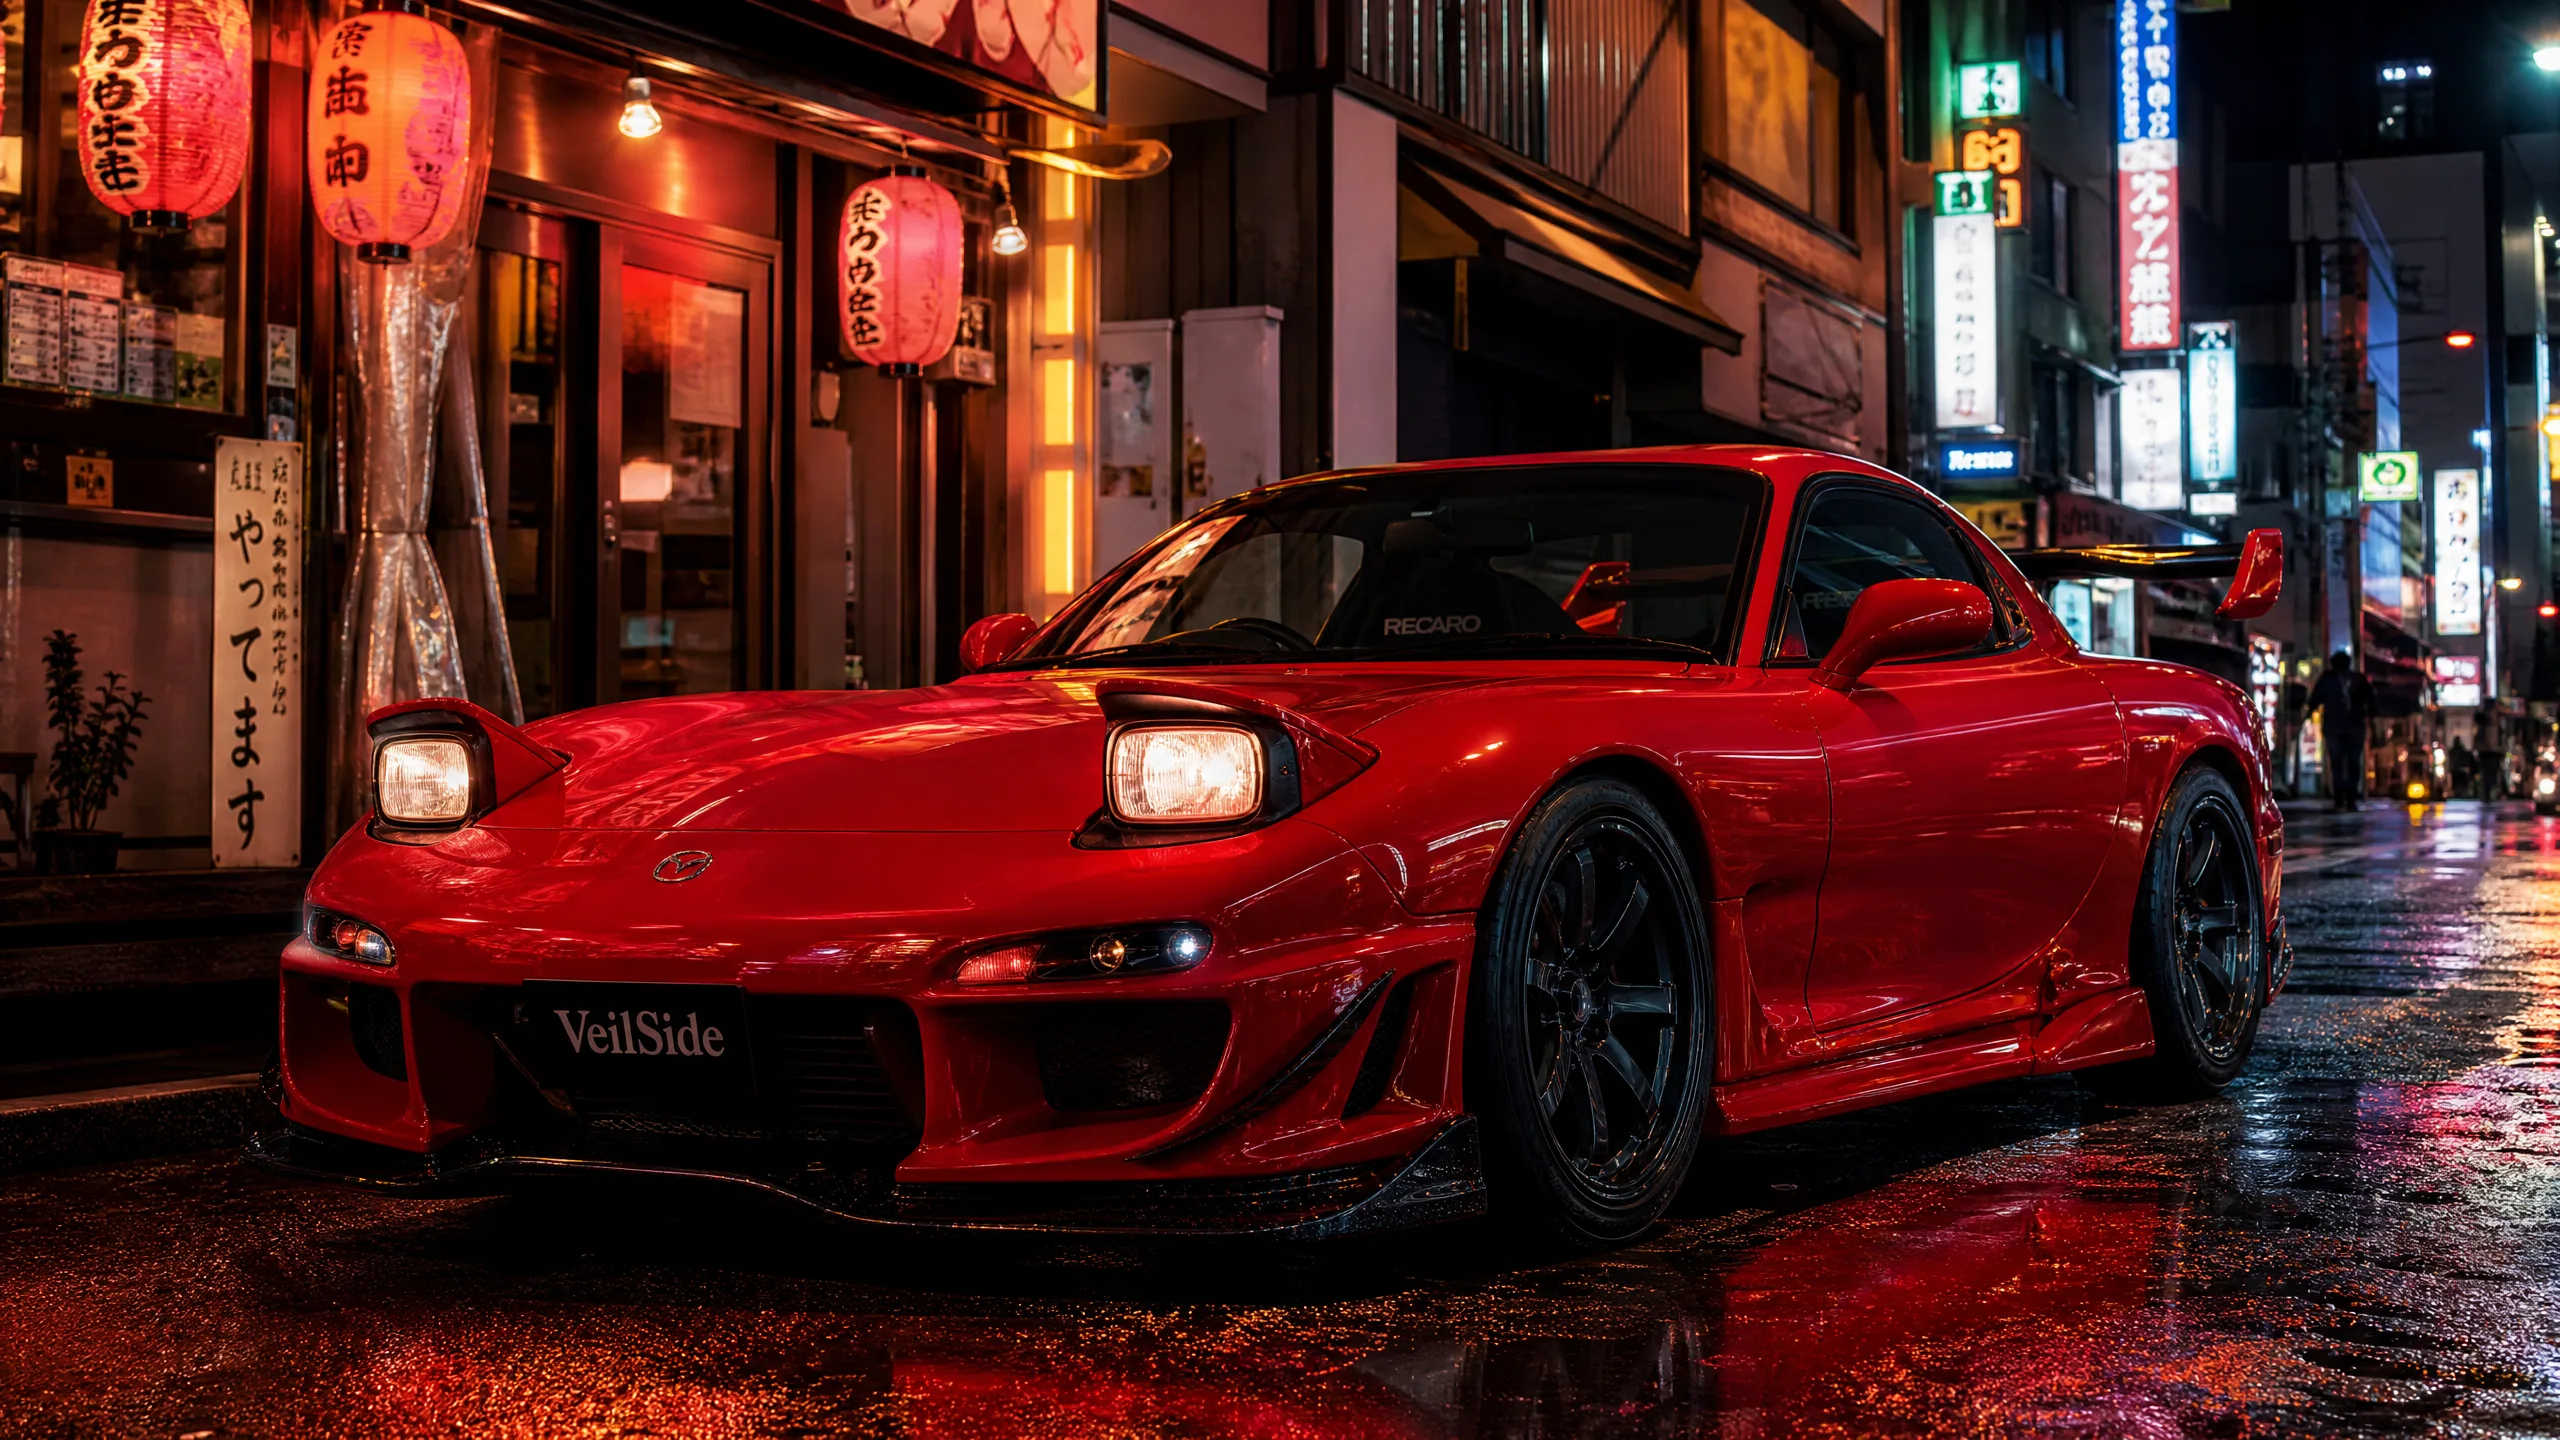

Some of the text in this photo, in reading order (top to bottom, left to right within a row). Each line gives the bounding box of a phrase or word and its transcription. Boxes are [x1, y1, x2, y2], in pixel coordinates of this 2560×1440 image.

[1384, 615, 1481, 635] RECARO
[228, 509, 265, 851] やってます
[553, 1010, 725, 1057] VeilSide
